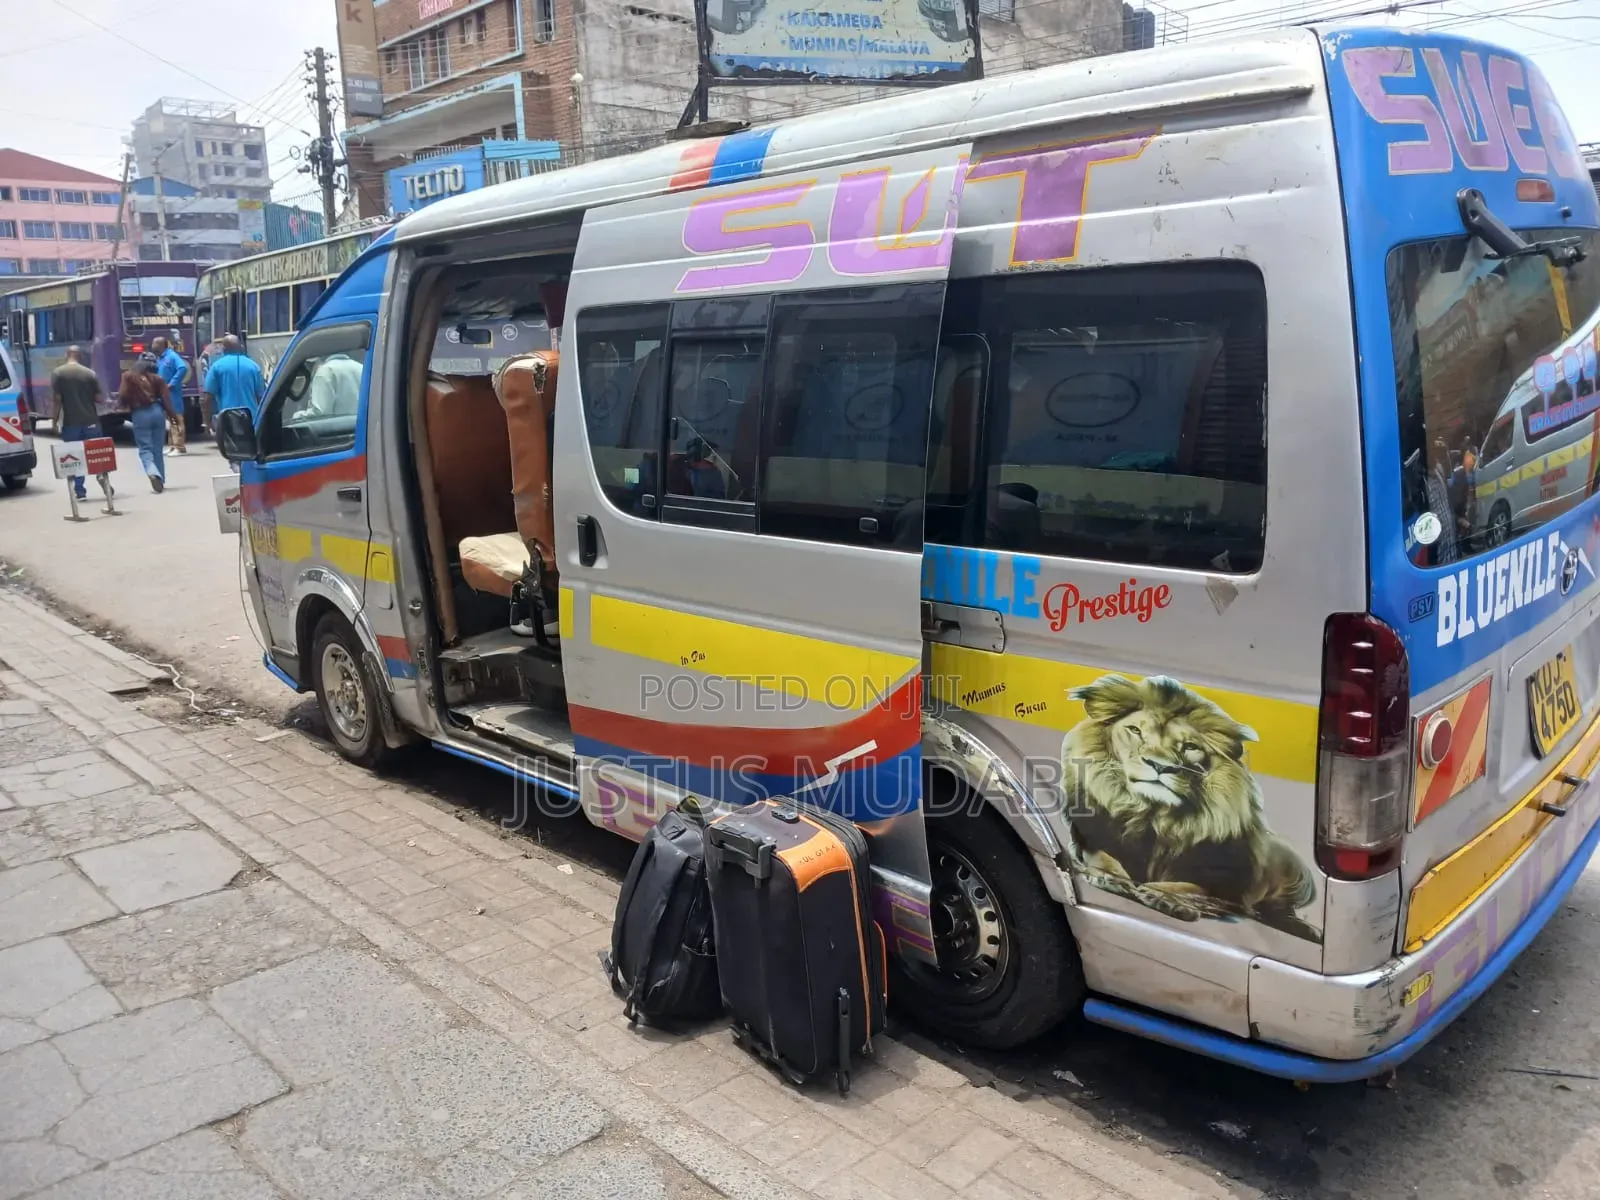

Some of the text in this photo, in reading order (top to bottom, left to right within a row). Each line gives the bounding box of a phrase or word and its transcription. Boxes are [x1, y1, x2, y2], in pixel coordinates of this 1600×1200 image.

[787, 11, 883, 29] KAKAMEGA
[402, 164, 464, 200] TECNO
[1043, 578, 1173, 632] Prestige
[1437, 531, 1560, 648] BLUENILE
[1411, 596, 1433, 619] PSV
[962, 680, 1007, 707] Mumias
